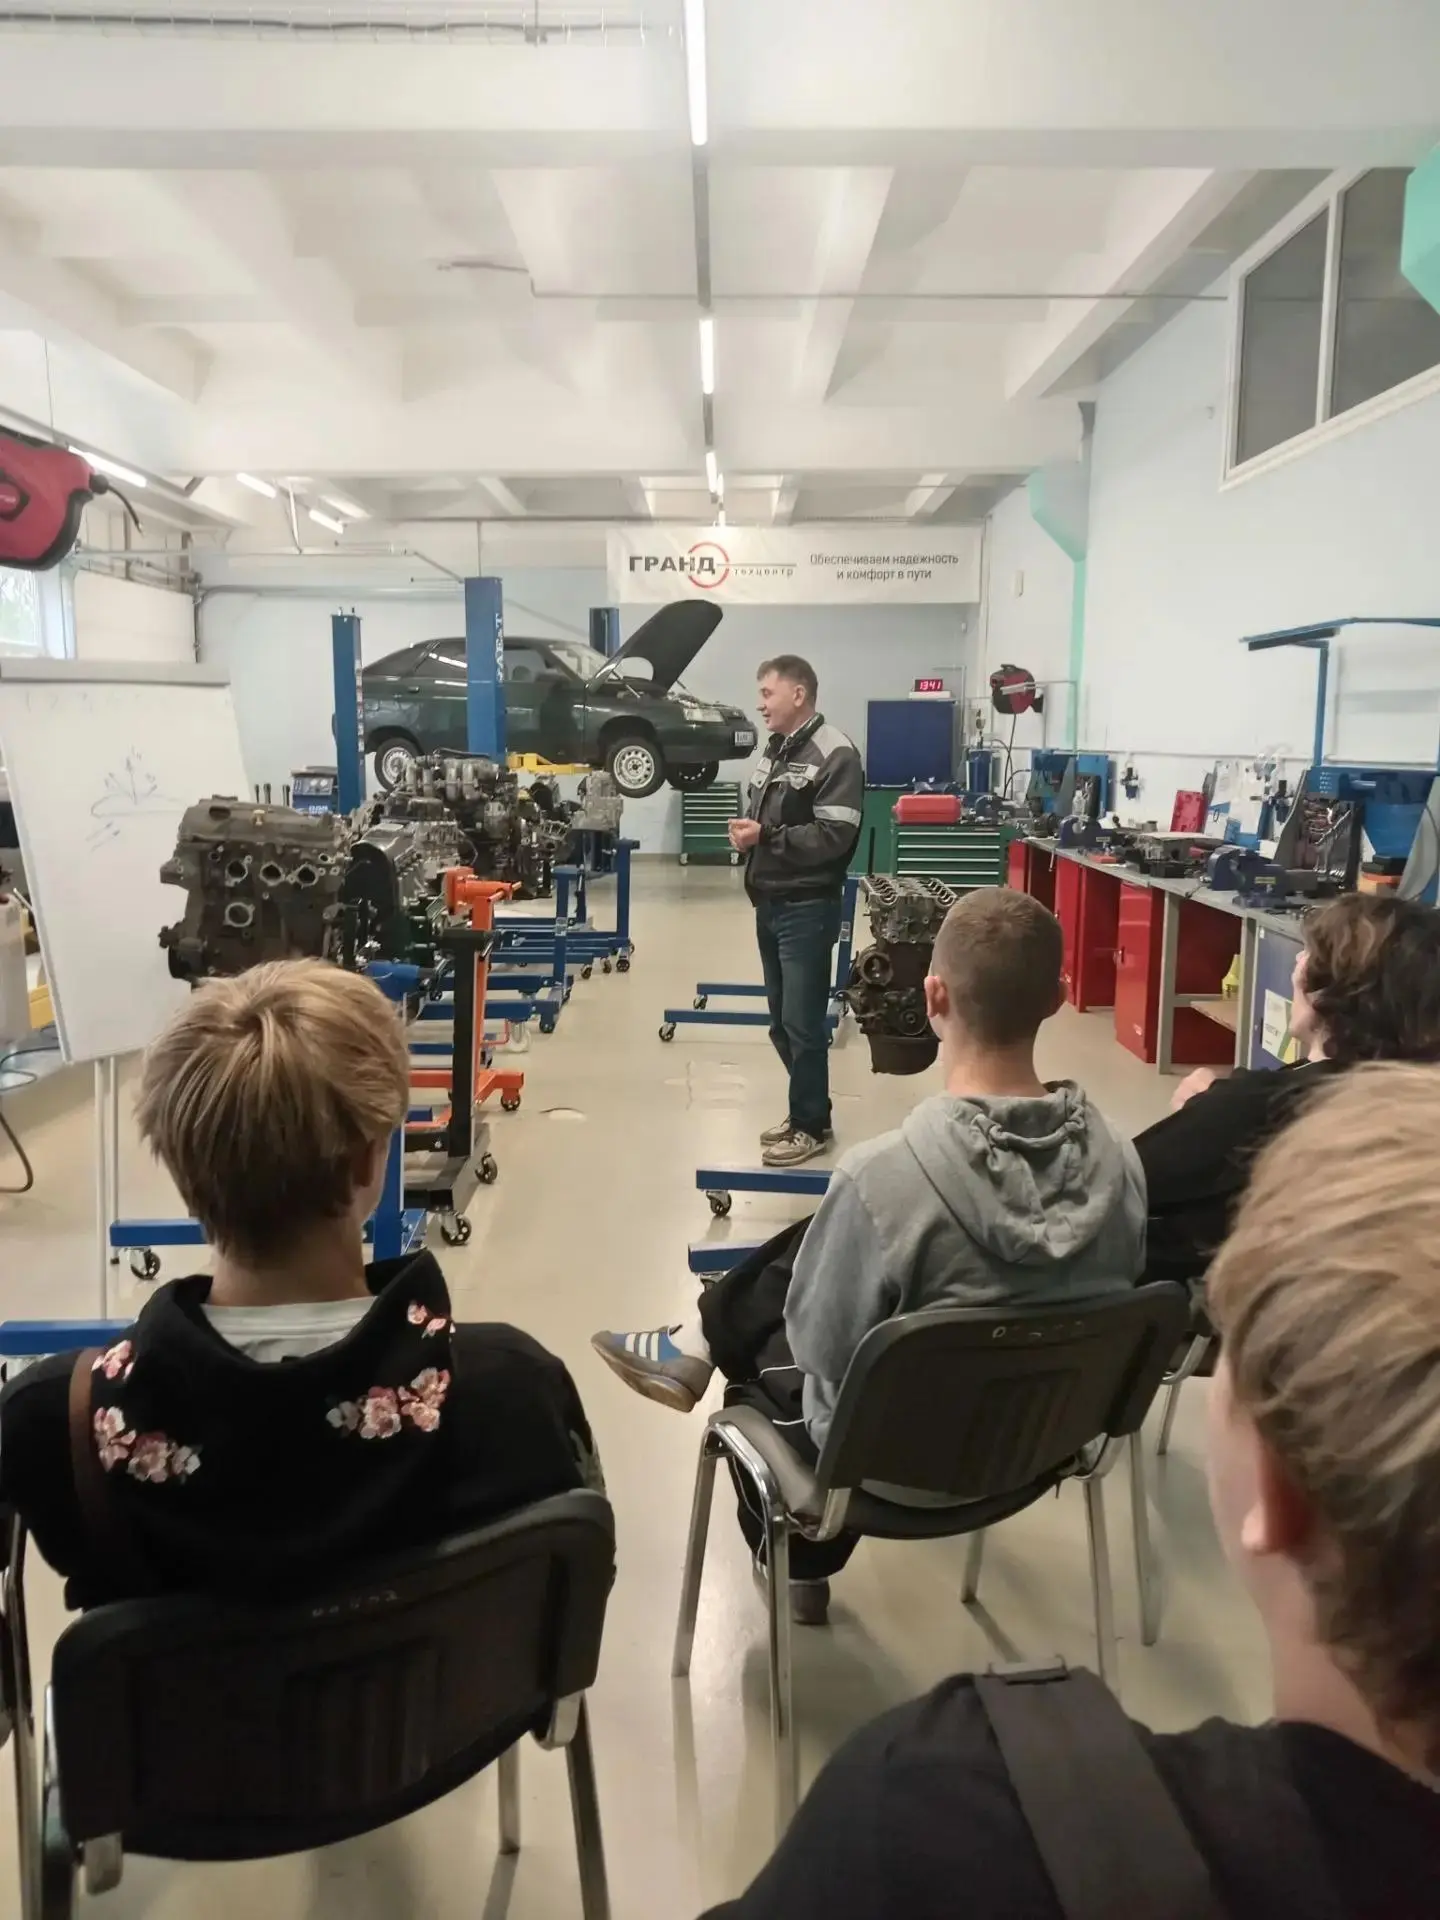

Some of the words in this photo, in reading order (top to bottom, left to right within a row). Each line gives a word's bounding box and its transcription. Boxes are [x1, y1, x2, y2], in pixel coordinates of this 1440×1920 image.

[629, 556, 715, 575] ГРАНД
[810, 554, 889, 565] Обеспечиваем
[837, 571, 844, 580] и
[847, 569, 895, 582] комфорт
[897, 570, 904, 580] в
[907, 570, 932, 581] пути
